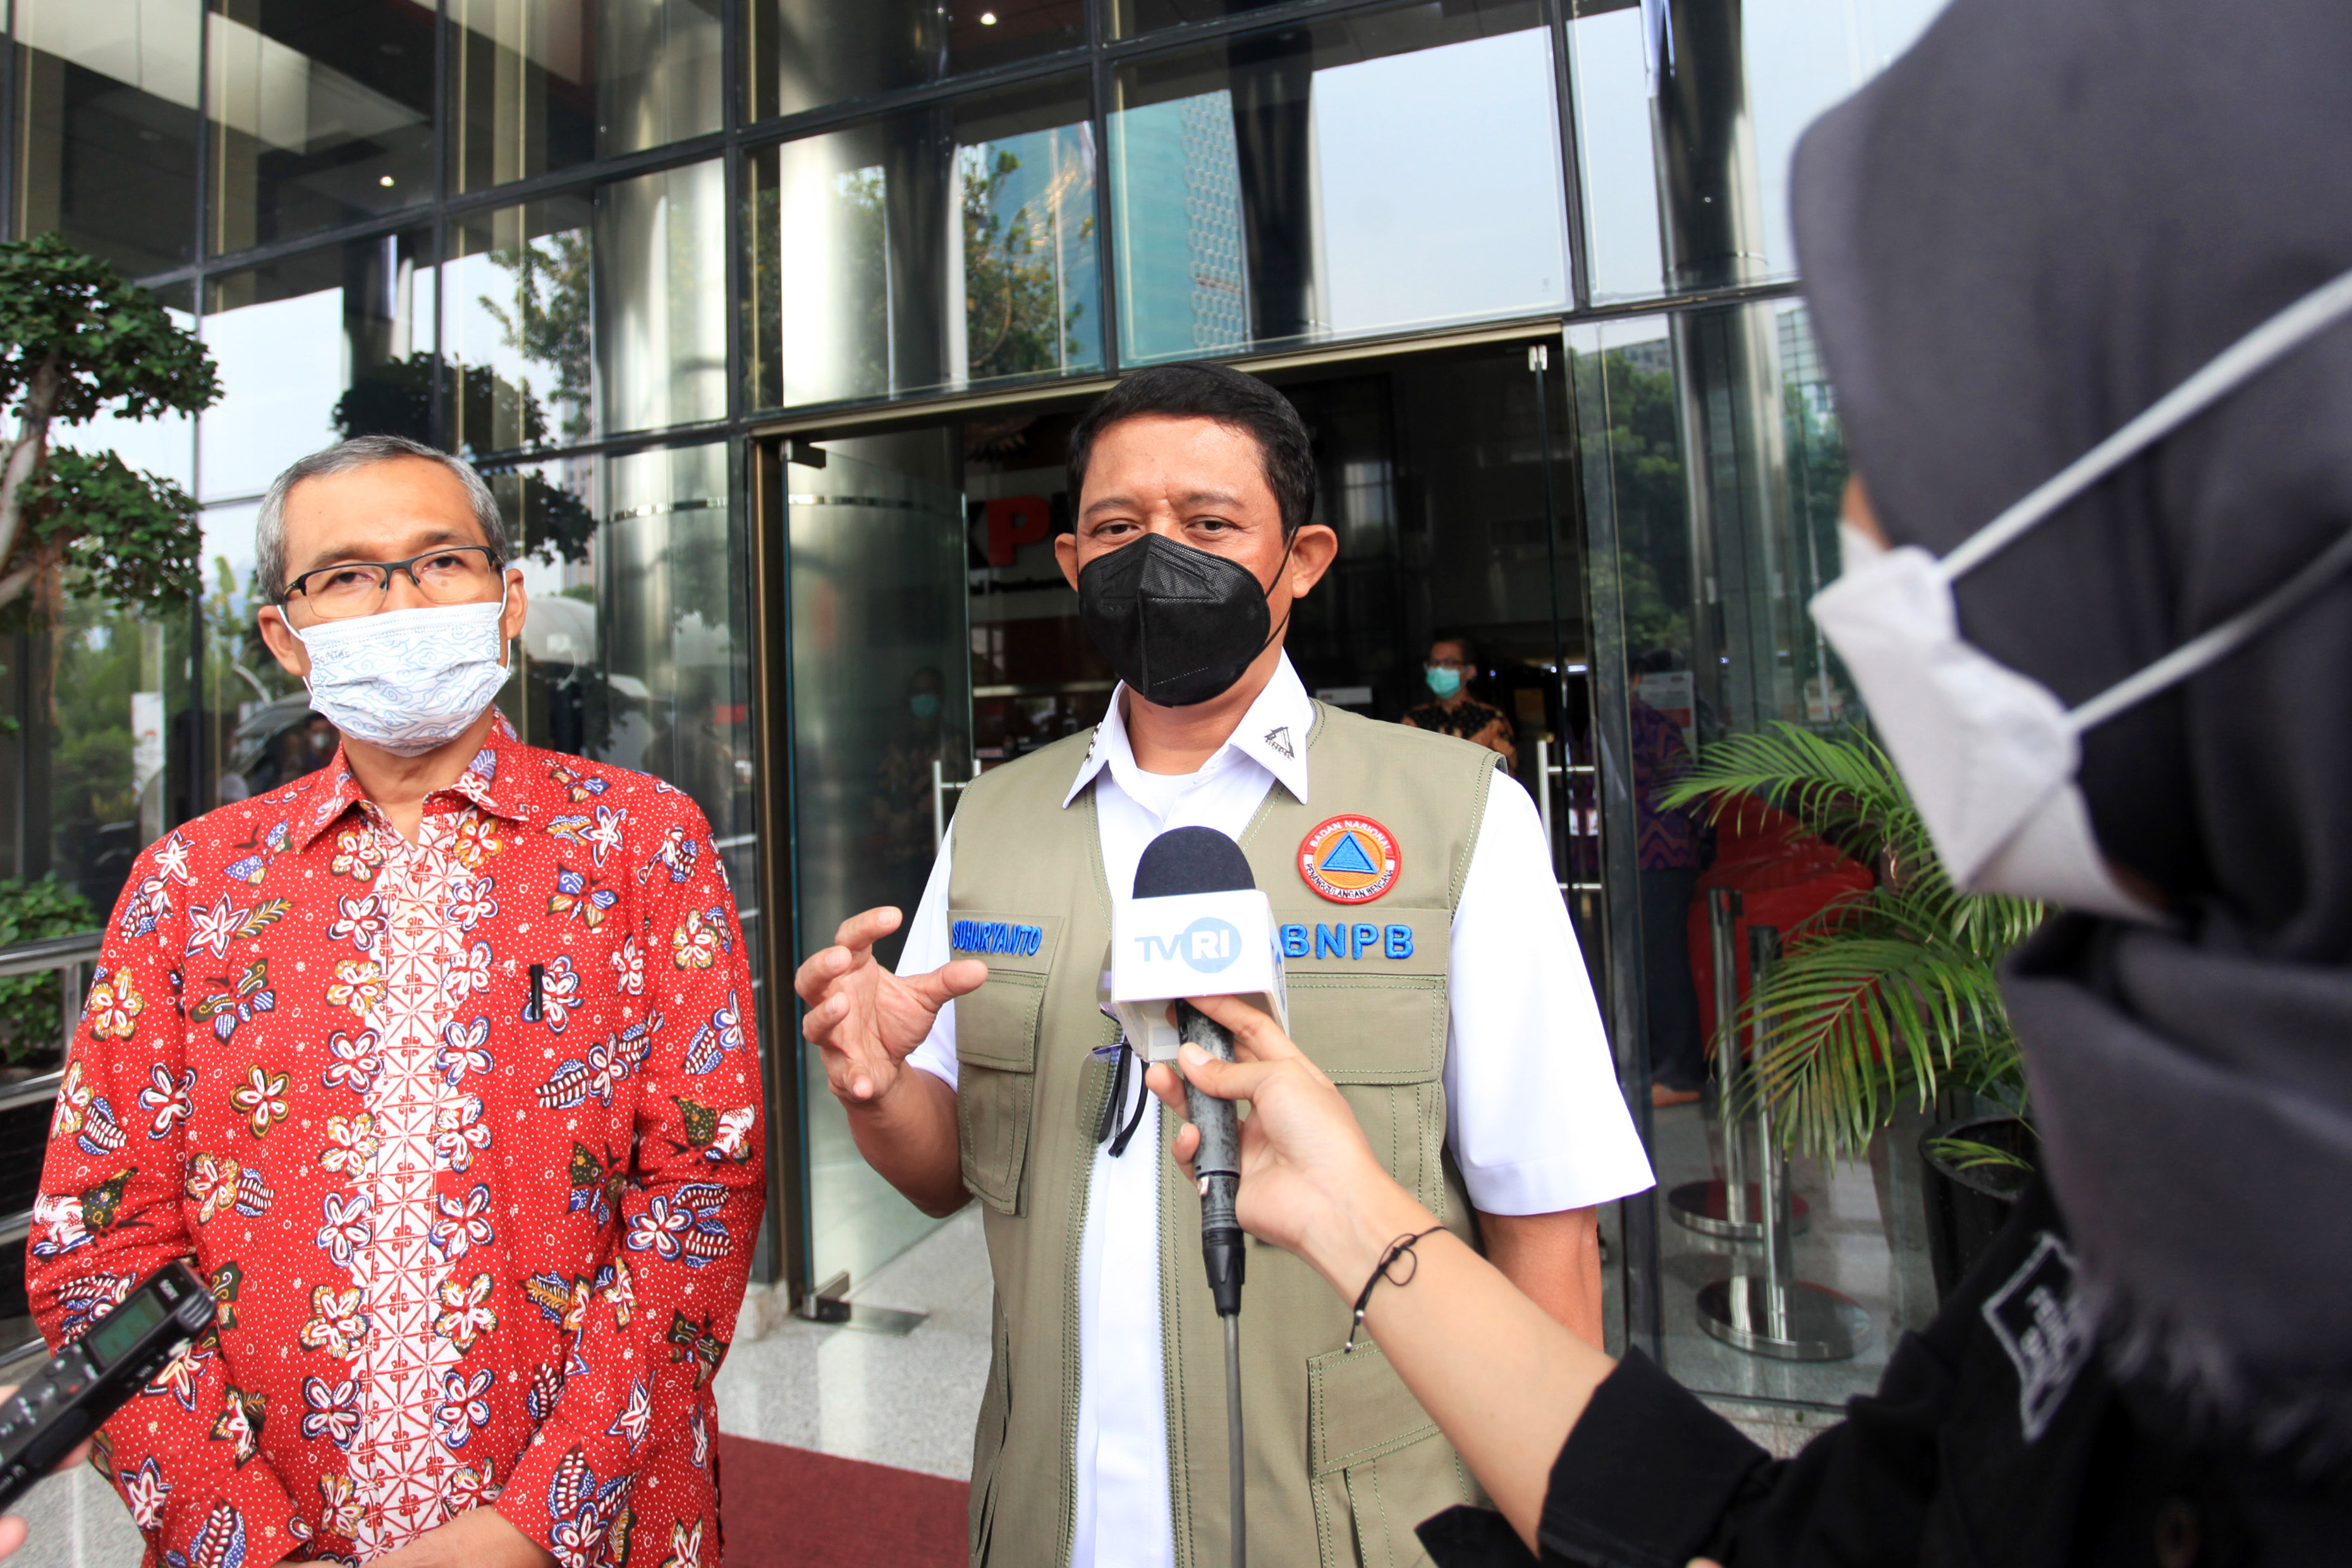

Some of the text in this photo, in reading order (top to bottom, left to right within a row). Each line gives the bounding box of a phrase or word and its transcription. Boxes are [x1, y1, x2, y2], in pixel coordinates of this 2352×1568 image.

[1309, 820, 1391, 852] BADAN NASIONAL
[1306, 863, 1394, 899] PENANGGULANGAN BENCANA
[952, 920, 1042, 956] SUHARYANTO
[1135, 929, 1230, 963] TVRI
[1281, 923, 1413, 960] BNPB
